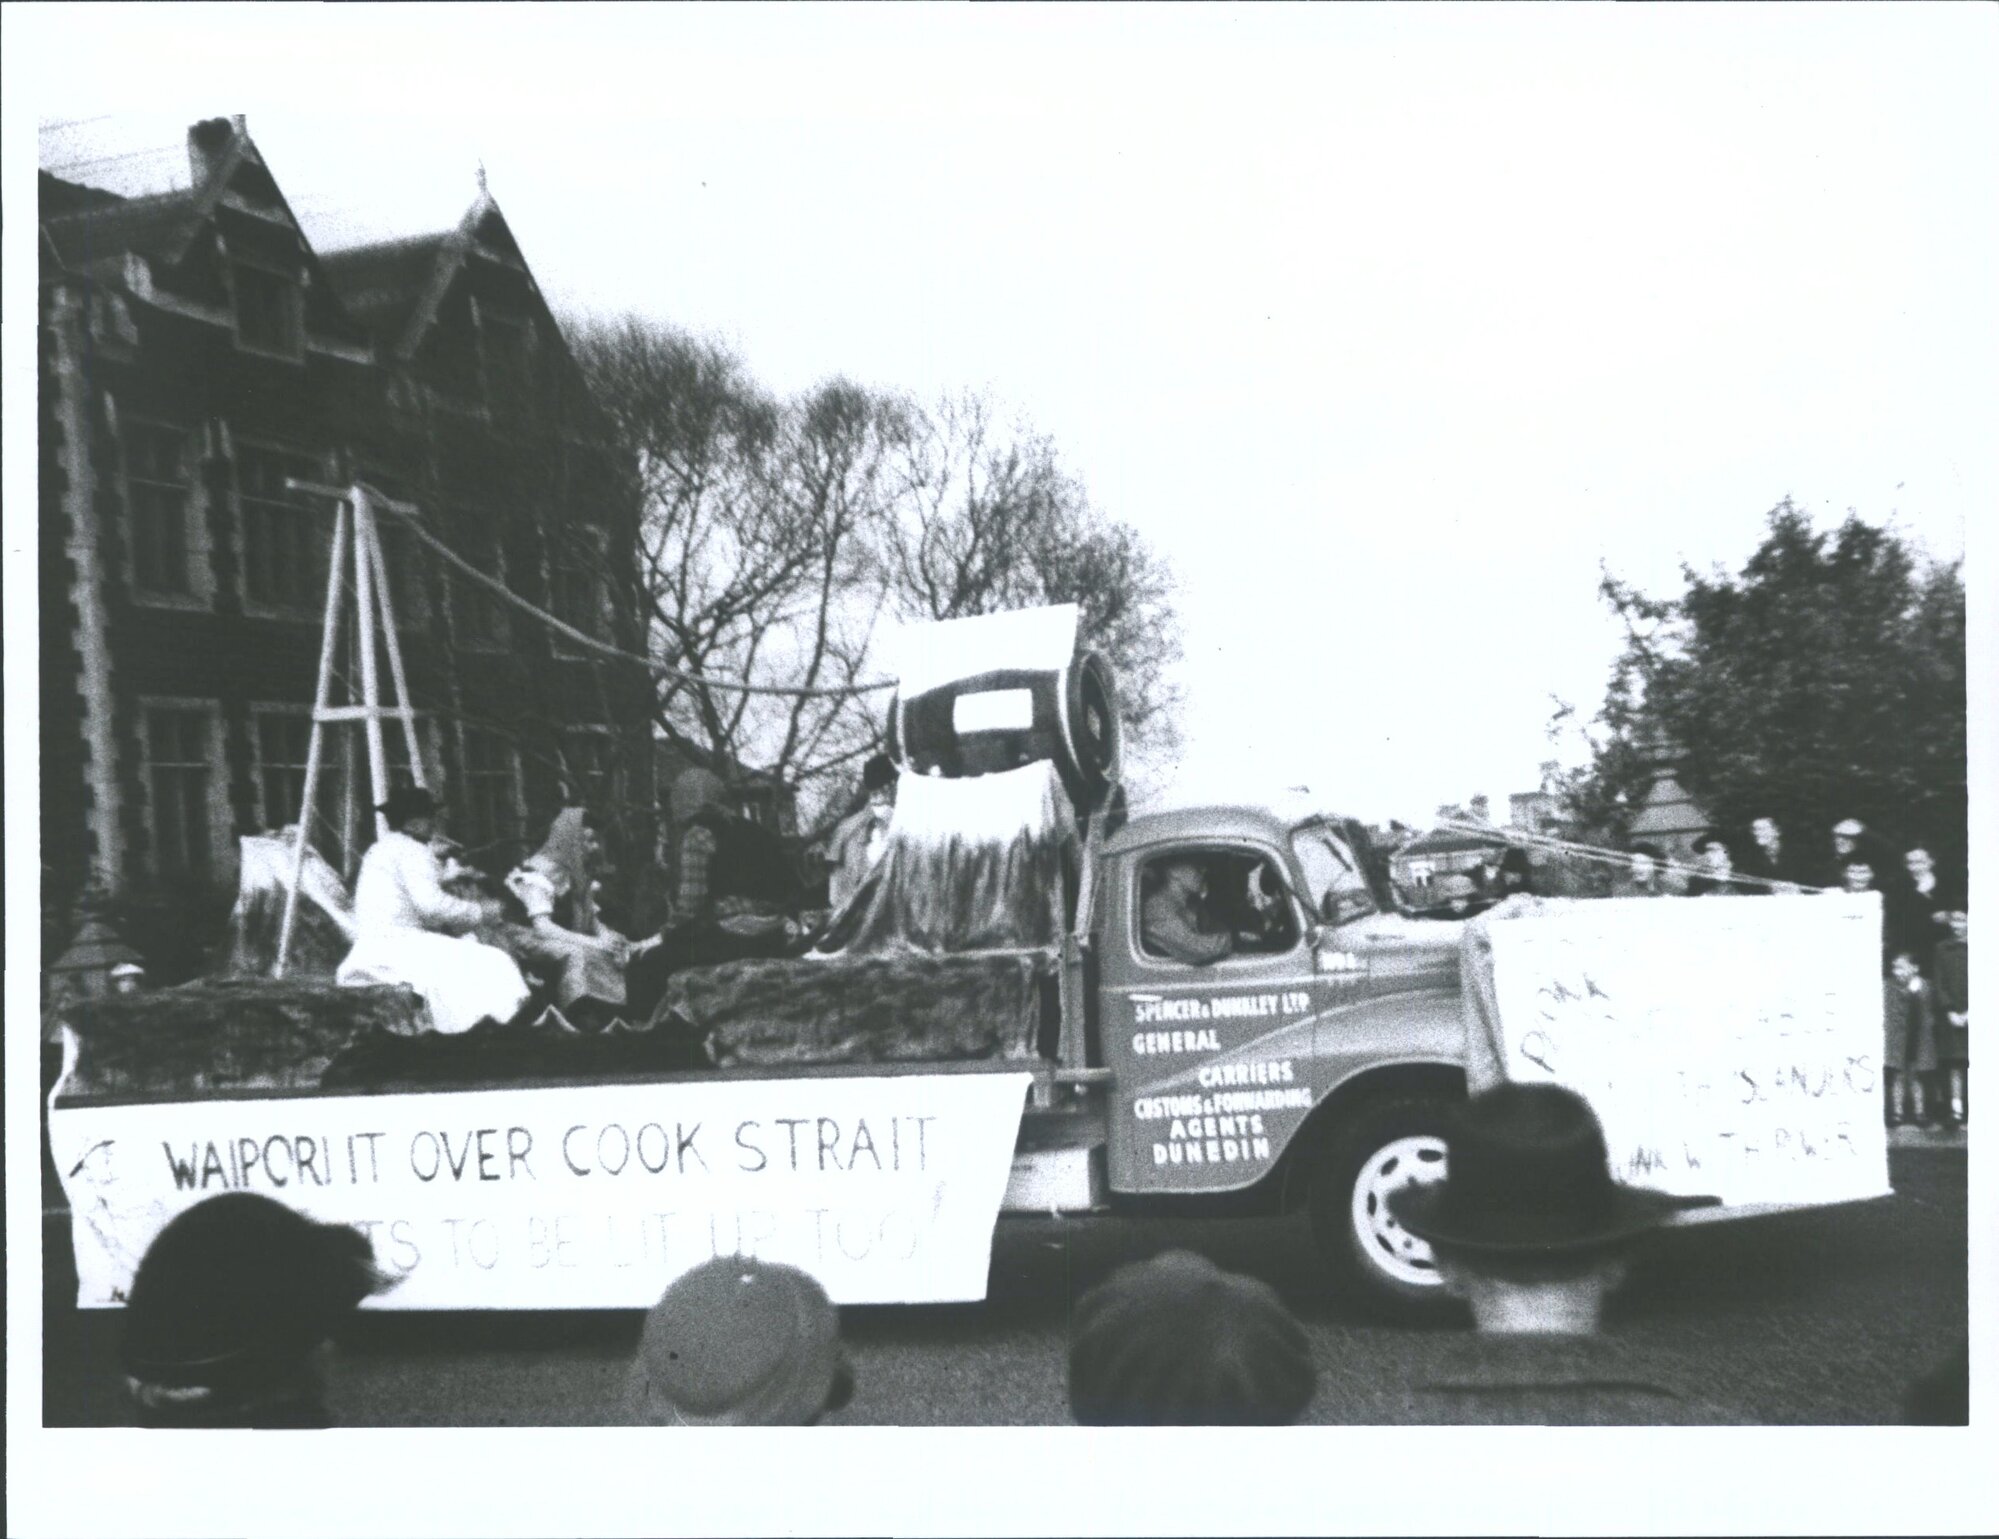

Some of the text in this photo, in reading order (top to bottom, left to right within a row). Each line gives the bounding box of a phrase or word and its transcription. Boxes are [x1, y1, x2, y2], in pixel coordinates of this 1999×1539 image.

[1132, 1029, 1221, 1055] GENERAL
[1199, 1060, 1293, 1088] CARRIERS
[1134, 1095, 1202, 1120] CUSTOMS
[1169, 1114, 1264, 1140] AGENTS
[410, 1126, 538, 1182] OVER
[562, 1121, 710, 1177] COOK
[734, 1116, 937, 1173] STRAIT
[1153, 1137, 1270, 1165] DUNEDIN
[440, 1217, 500, 1271] TO
